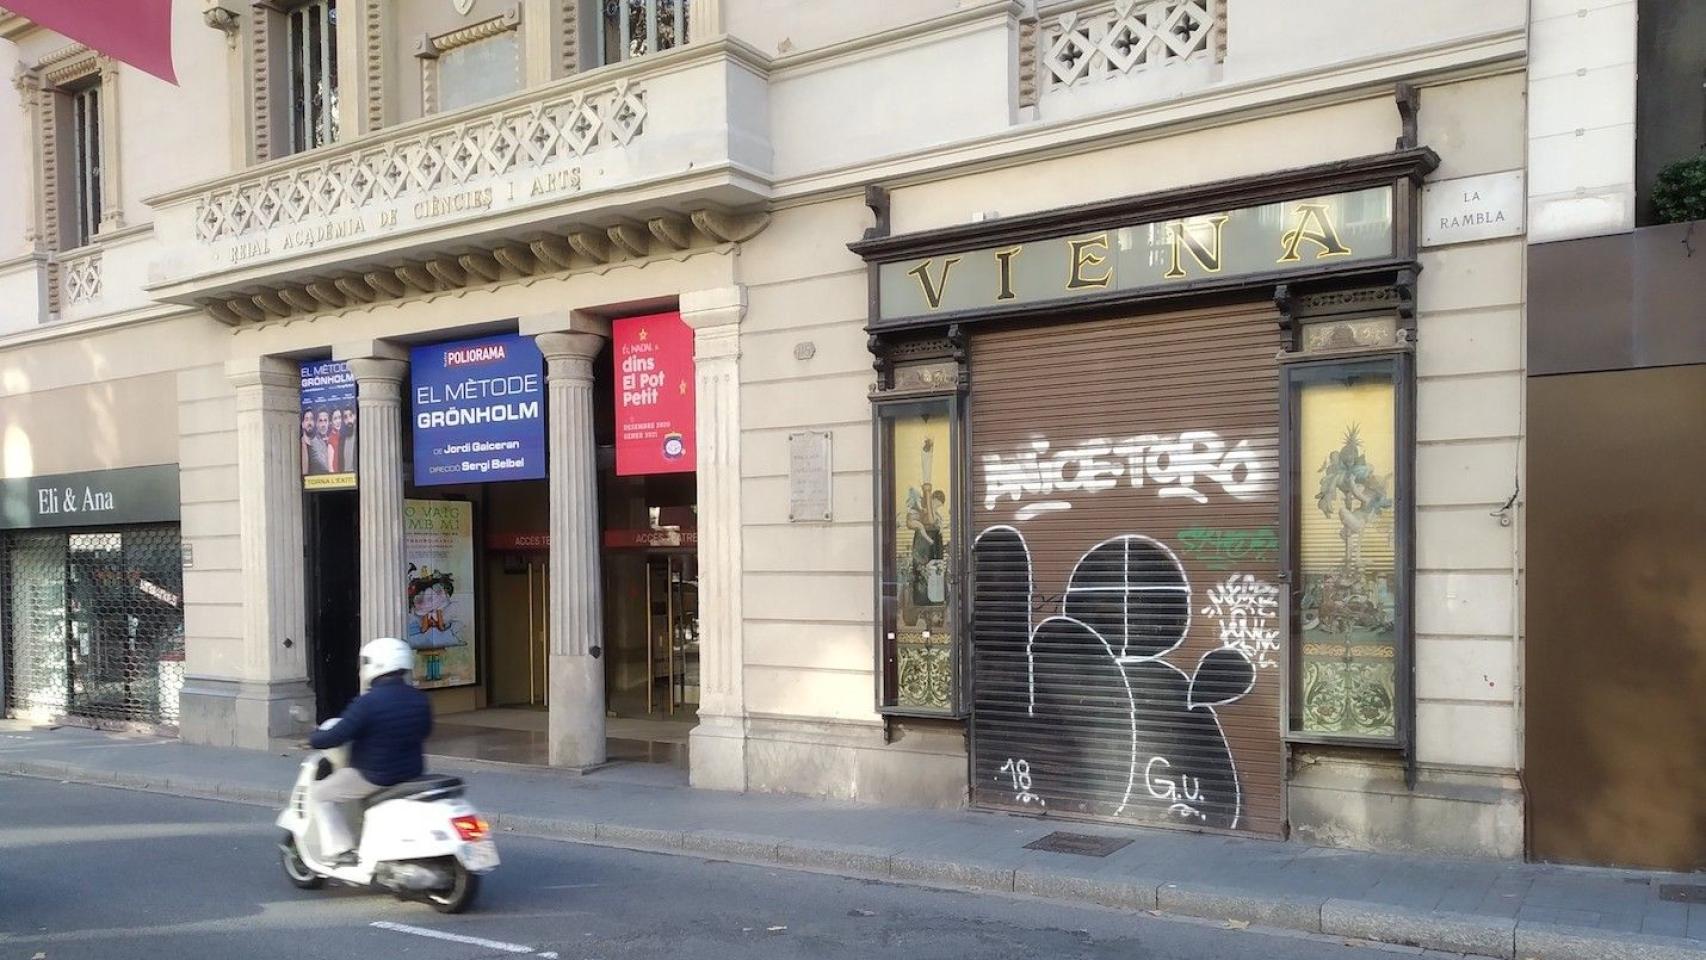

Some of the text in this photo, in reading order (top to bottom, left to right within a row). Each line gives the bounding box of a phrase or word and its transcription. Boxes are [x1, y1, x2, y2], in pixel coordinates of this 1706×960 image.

[1463, 191, 1481, 203] LA
[230, 239, 271, 263] REIAL
[380, 209, 398, 228] DE
[413, 187, 493, 220] CIÈNCIES
[507, 181, 514, 200] I
[531, 166, 581, 197] ARTS
[1440, 210, 1505, 229] RAMBLA
[908, 203, 1352, 310] VIENA
[448, 345, 506, 365] POLIORAMA
[622, 354, 656, 373] dins
[301, 362, 348, 378] EL MÈTOD
[301, 373, 354, 387] GRÖNHOLM
[417, 374, 538, 405] EL MÈTODE
[622, 370, 666, 391] El Pot
[622, 387, 658, 408] Petit
[417, 401, 539, 429] GRÖNHOLM
[444, 442, 471, 454] Jordi
[472, 440, 520, 452] Galceran
[461, 459, 490, 472] Sergi
[491, 457, 525, 470] Belbel
[38, 486, 115, 515] Eli & Ana
[406, 518, 434, 530] MB
